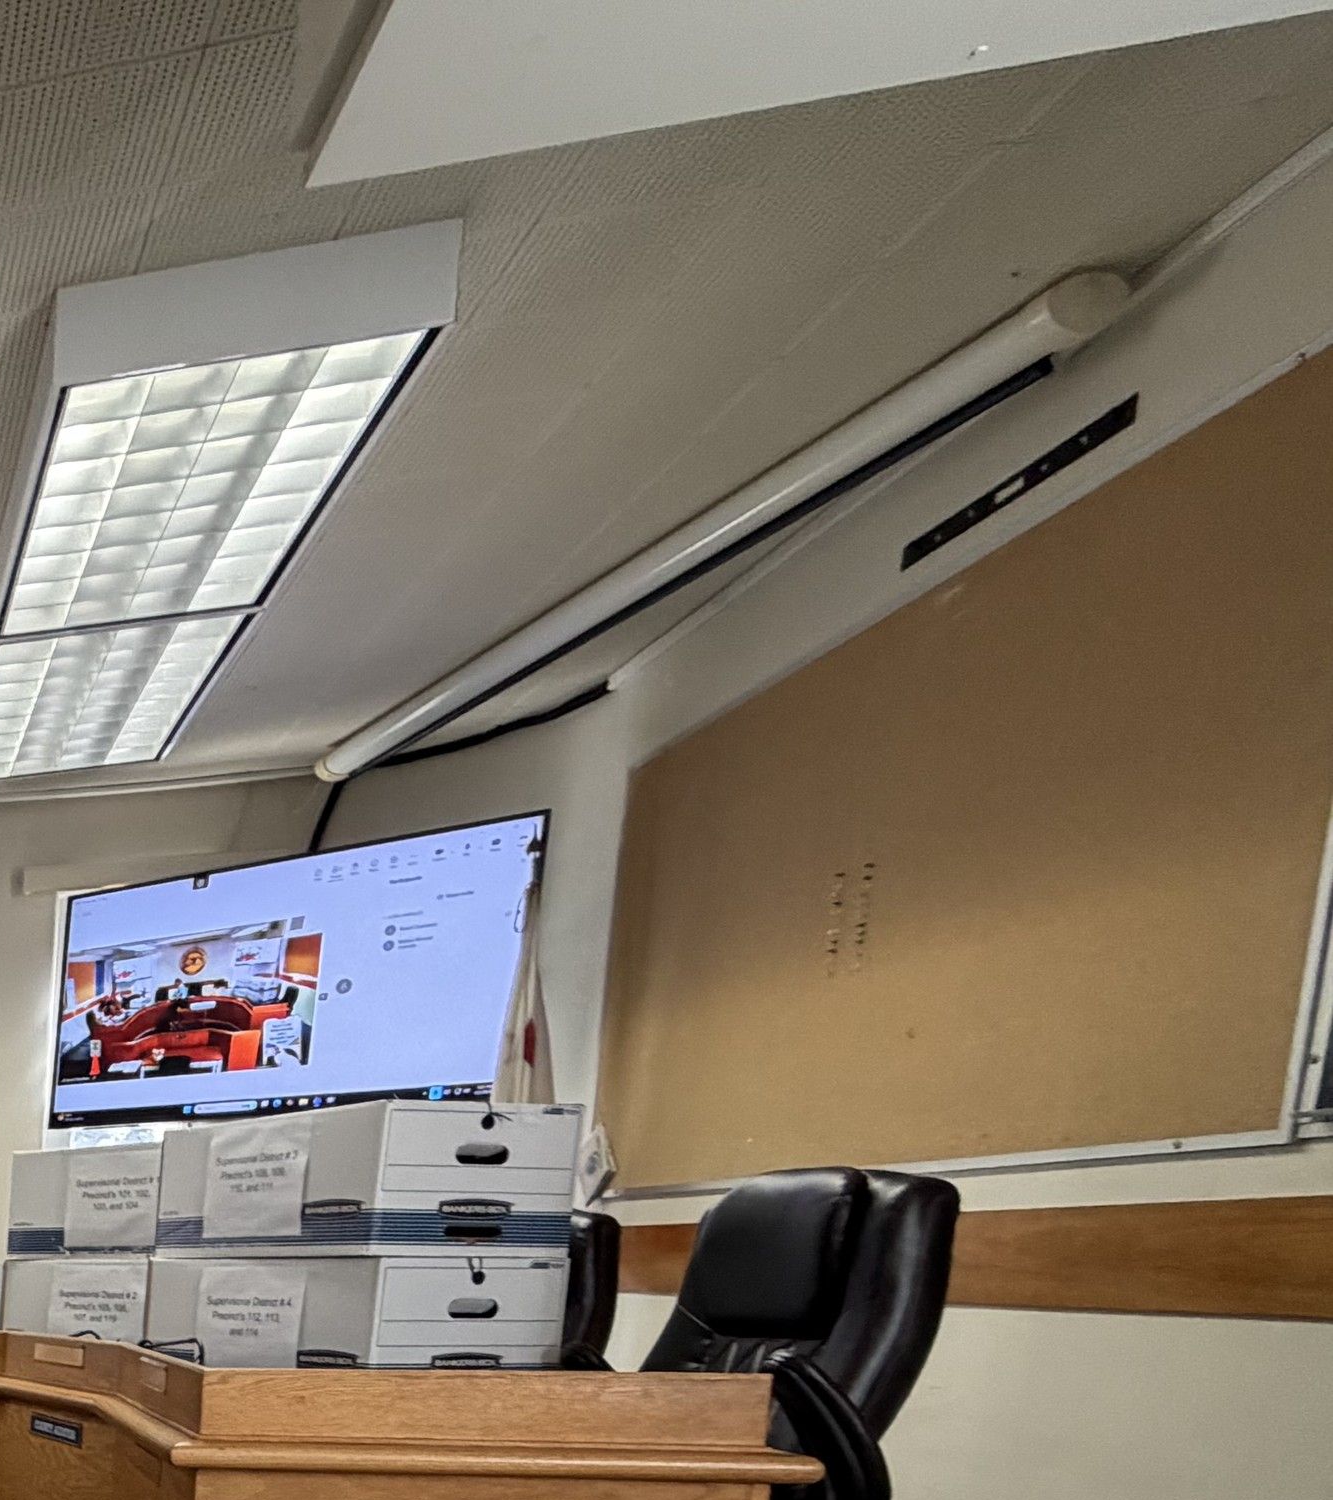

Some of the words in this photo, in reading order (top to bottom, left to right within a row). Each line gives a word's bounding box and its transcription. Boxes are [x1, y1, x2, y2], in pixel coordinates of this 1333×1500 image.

[259, 1152, 284, 1162] District
[122, 1177, 148, 1186] District
[109, 1202, 123, 1210] and
[100, 1290, 124, 1299] District
[253, 1296, 278, 1307] District
[229, 1328, 244, 1336] and
